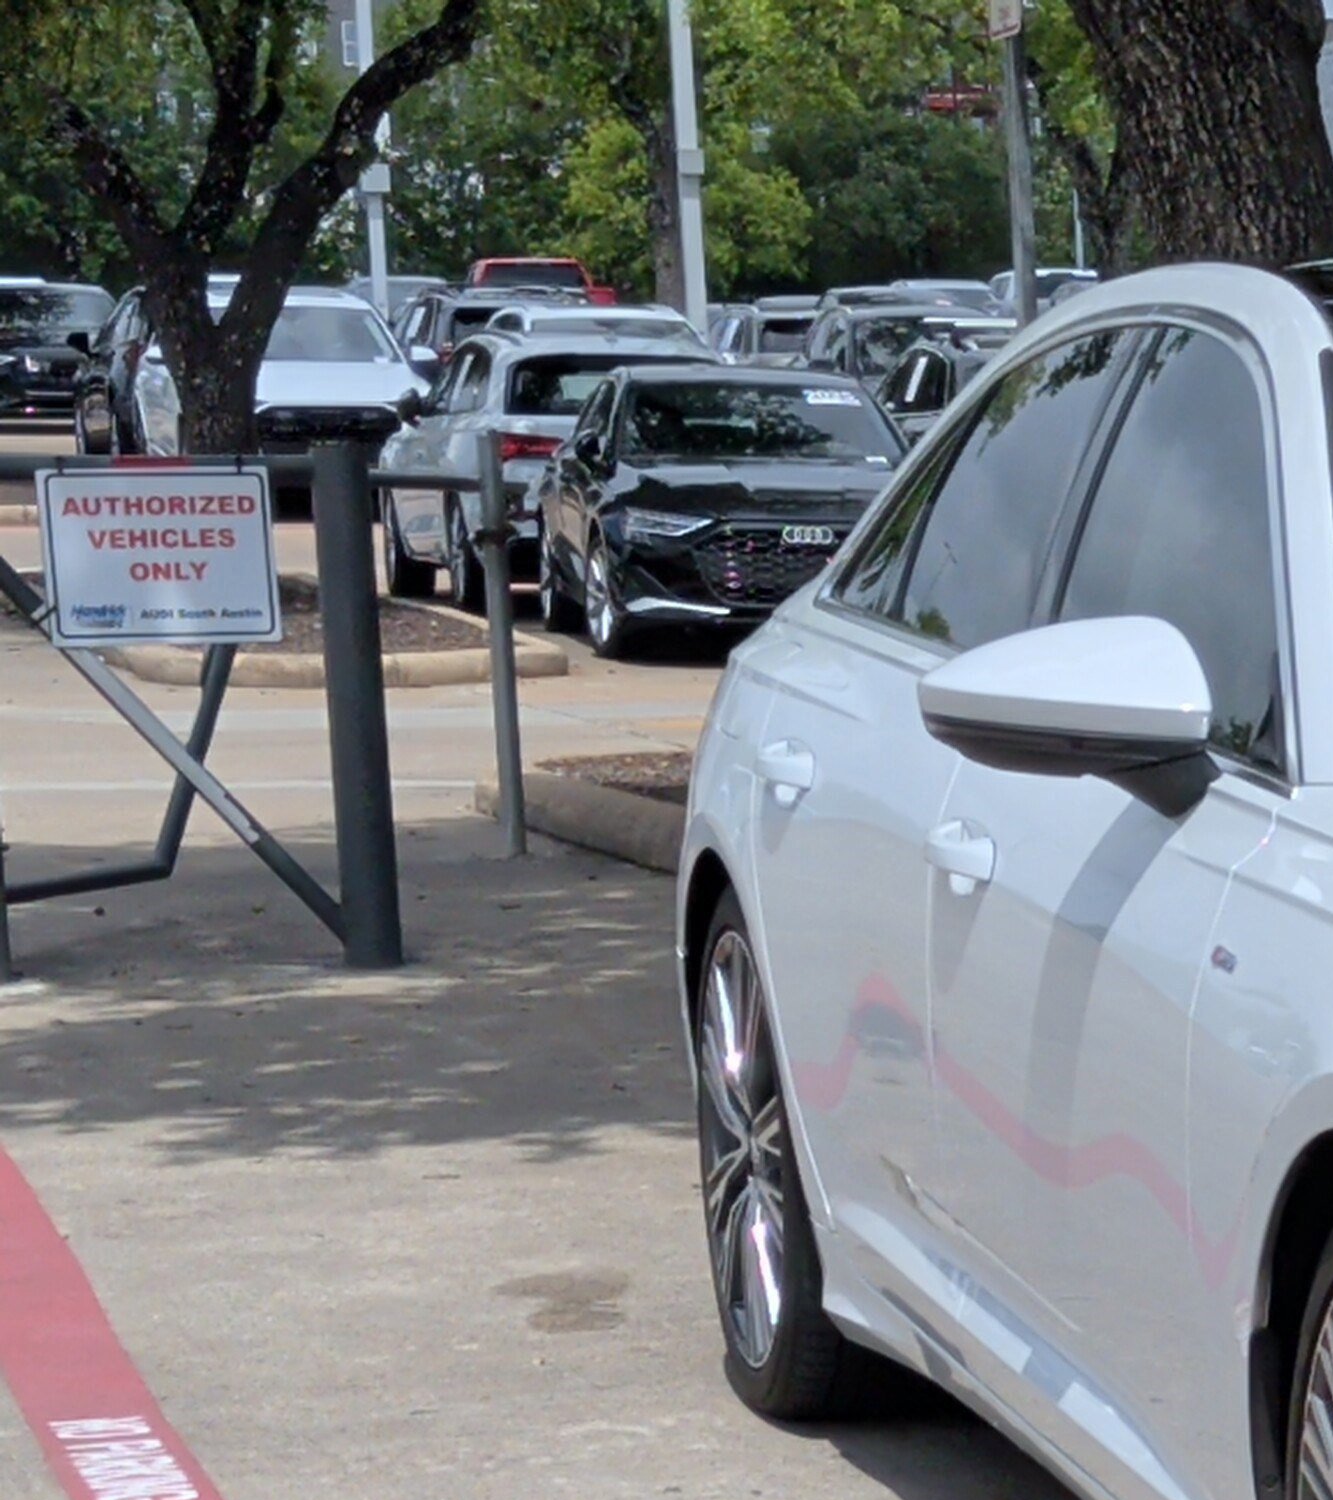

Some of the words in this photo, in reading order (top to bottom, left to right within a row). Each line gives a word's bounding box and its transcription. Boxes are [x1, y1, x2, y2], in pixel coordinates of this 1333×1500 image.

[62, 495, 256, 516] AUTHORIZED
[87, 528, 236, 549] VEHICLES
[130, 562, 208, 582] ONLY
